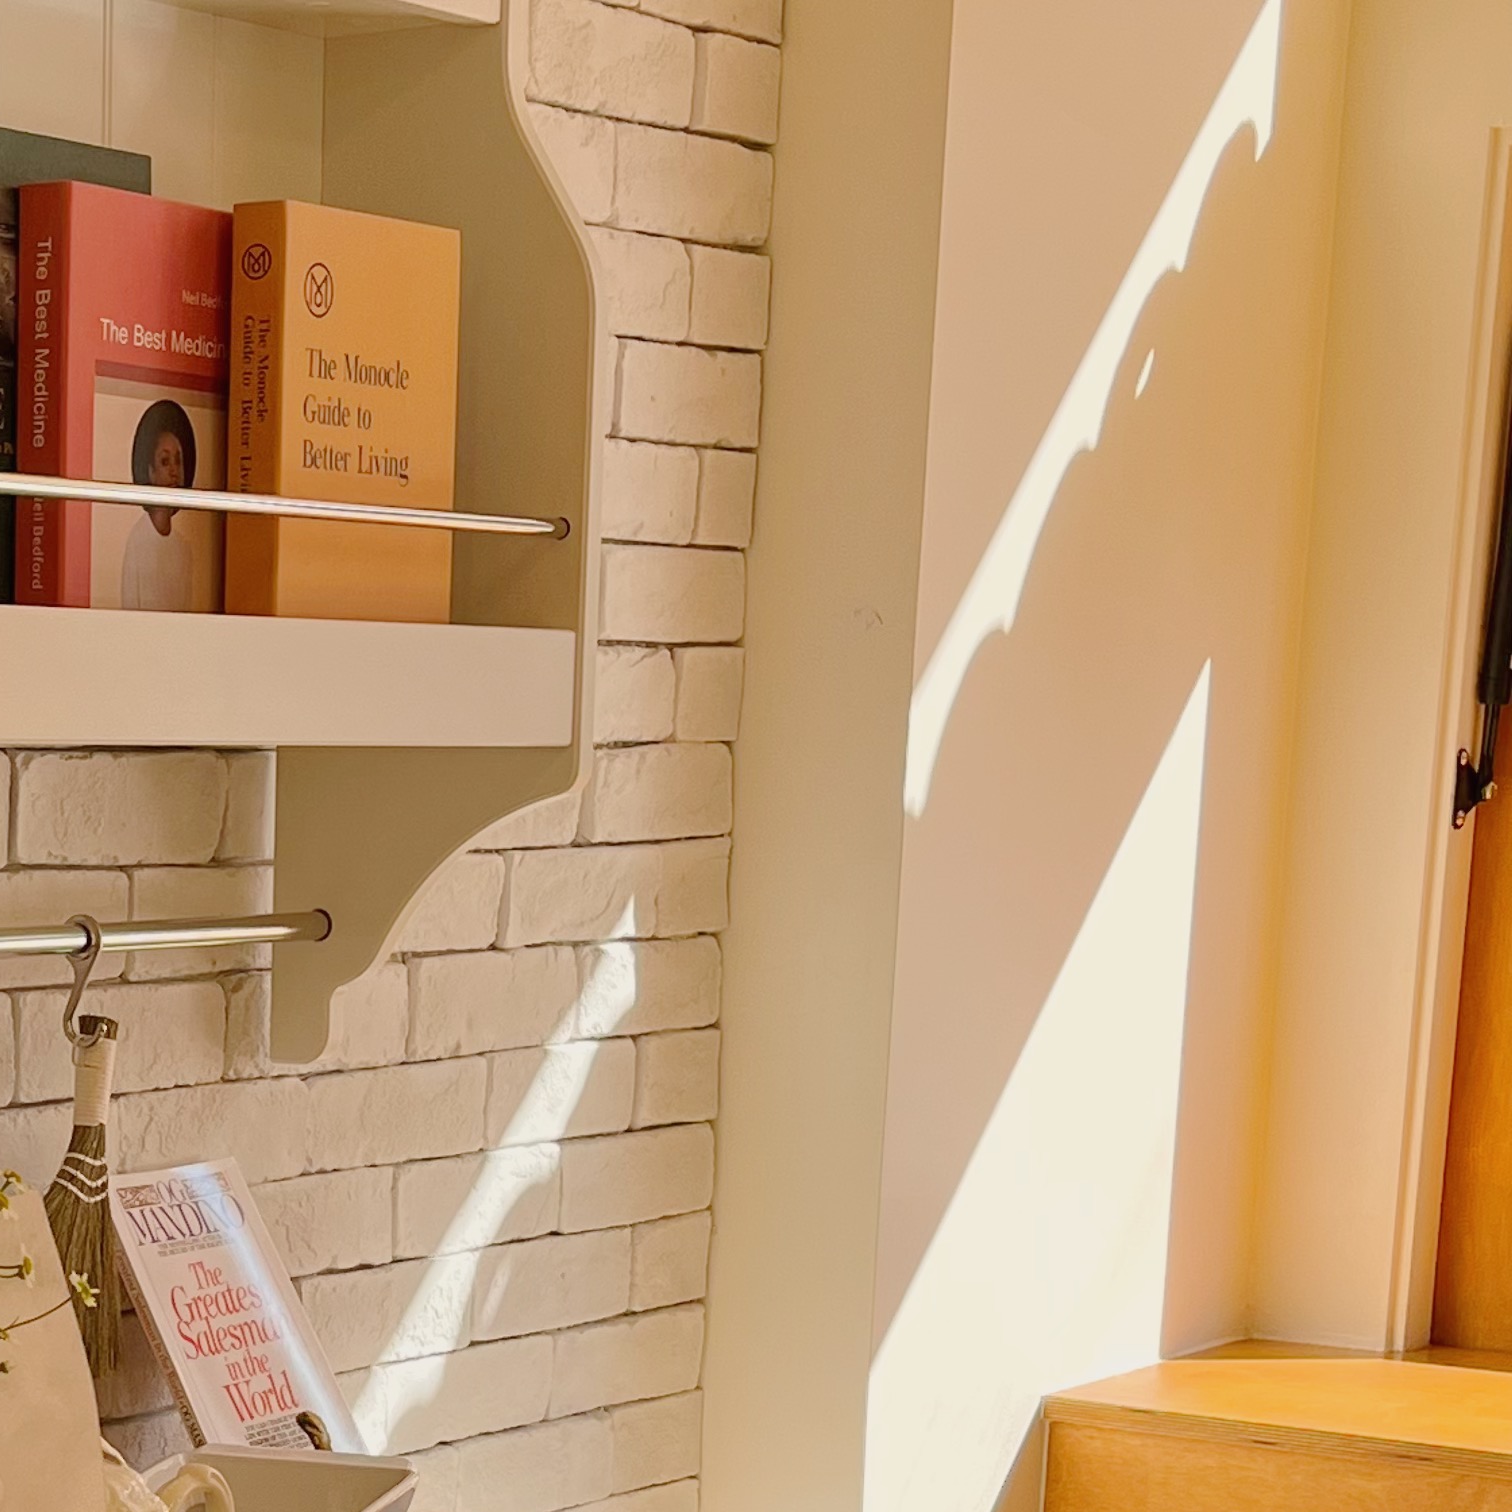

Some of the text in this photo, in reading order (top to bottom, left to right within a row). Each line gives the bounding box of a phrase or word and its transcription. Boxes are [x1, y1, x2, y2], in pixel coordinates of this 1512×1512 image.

[32, 237, 53, 448] The Best Medicine
[100, 318, 128, 345] The
[133, 324, 167, 352] Best
[241, 315, 255, 366] Guide
[241, 370, 253, 387] to
[256, 315, 271, 423] The Monocle
[305, 347, 410, 390] The Monocle
[240, 400, 253, 449] Better
[303, 393, 372, 430] Guide to
[303, 439, 409, 487] Better Living
[32, 526, 44, 590] Bedford
[156, 1178, 186, 1203] OG
[189, 1261, 225, 1291] The
[170, 1283, 264, 1325] Greates
[177, 1315, 284, 1360] Salesma
[224, 1350, 272, 1382] in the
[223, 1370, 300, 1423] World
